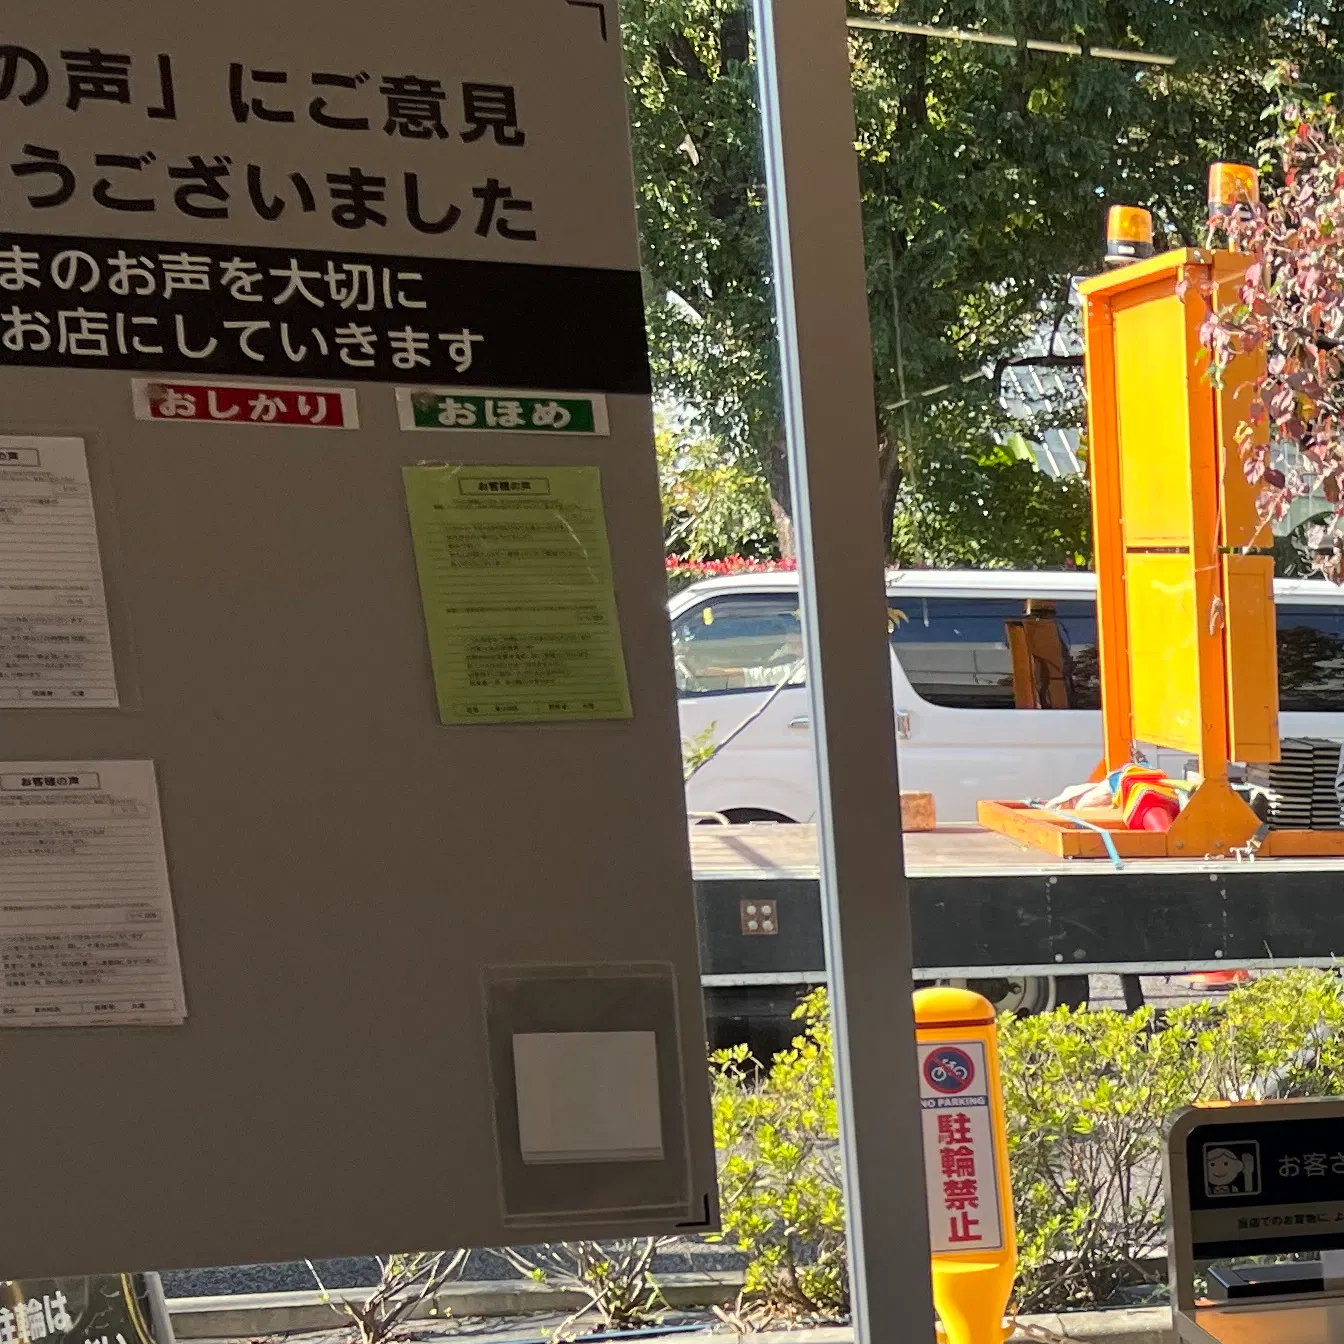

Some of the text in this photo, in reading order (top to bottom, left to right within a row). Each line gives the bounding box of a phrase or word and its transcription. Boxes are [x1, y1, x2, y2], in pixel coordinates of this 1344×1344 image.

[11, 143, 537, 241] うございました
[0, 244, 428, 311] まのお声を大切に
[1, 306, 485, 374] お店にしていきます
[160, 389, 329, 426] おしかり
[437, 396, 572, 429] おほめ
[938, 1096, 986, 1108] PARKING
[937, 1111, 984, 1243] 駐輪禁止
